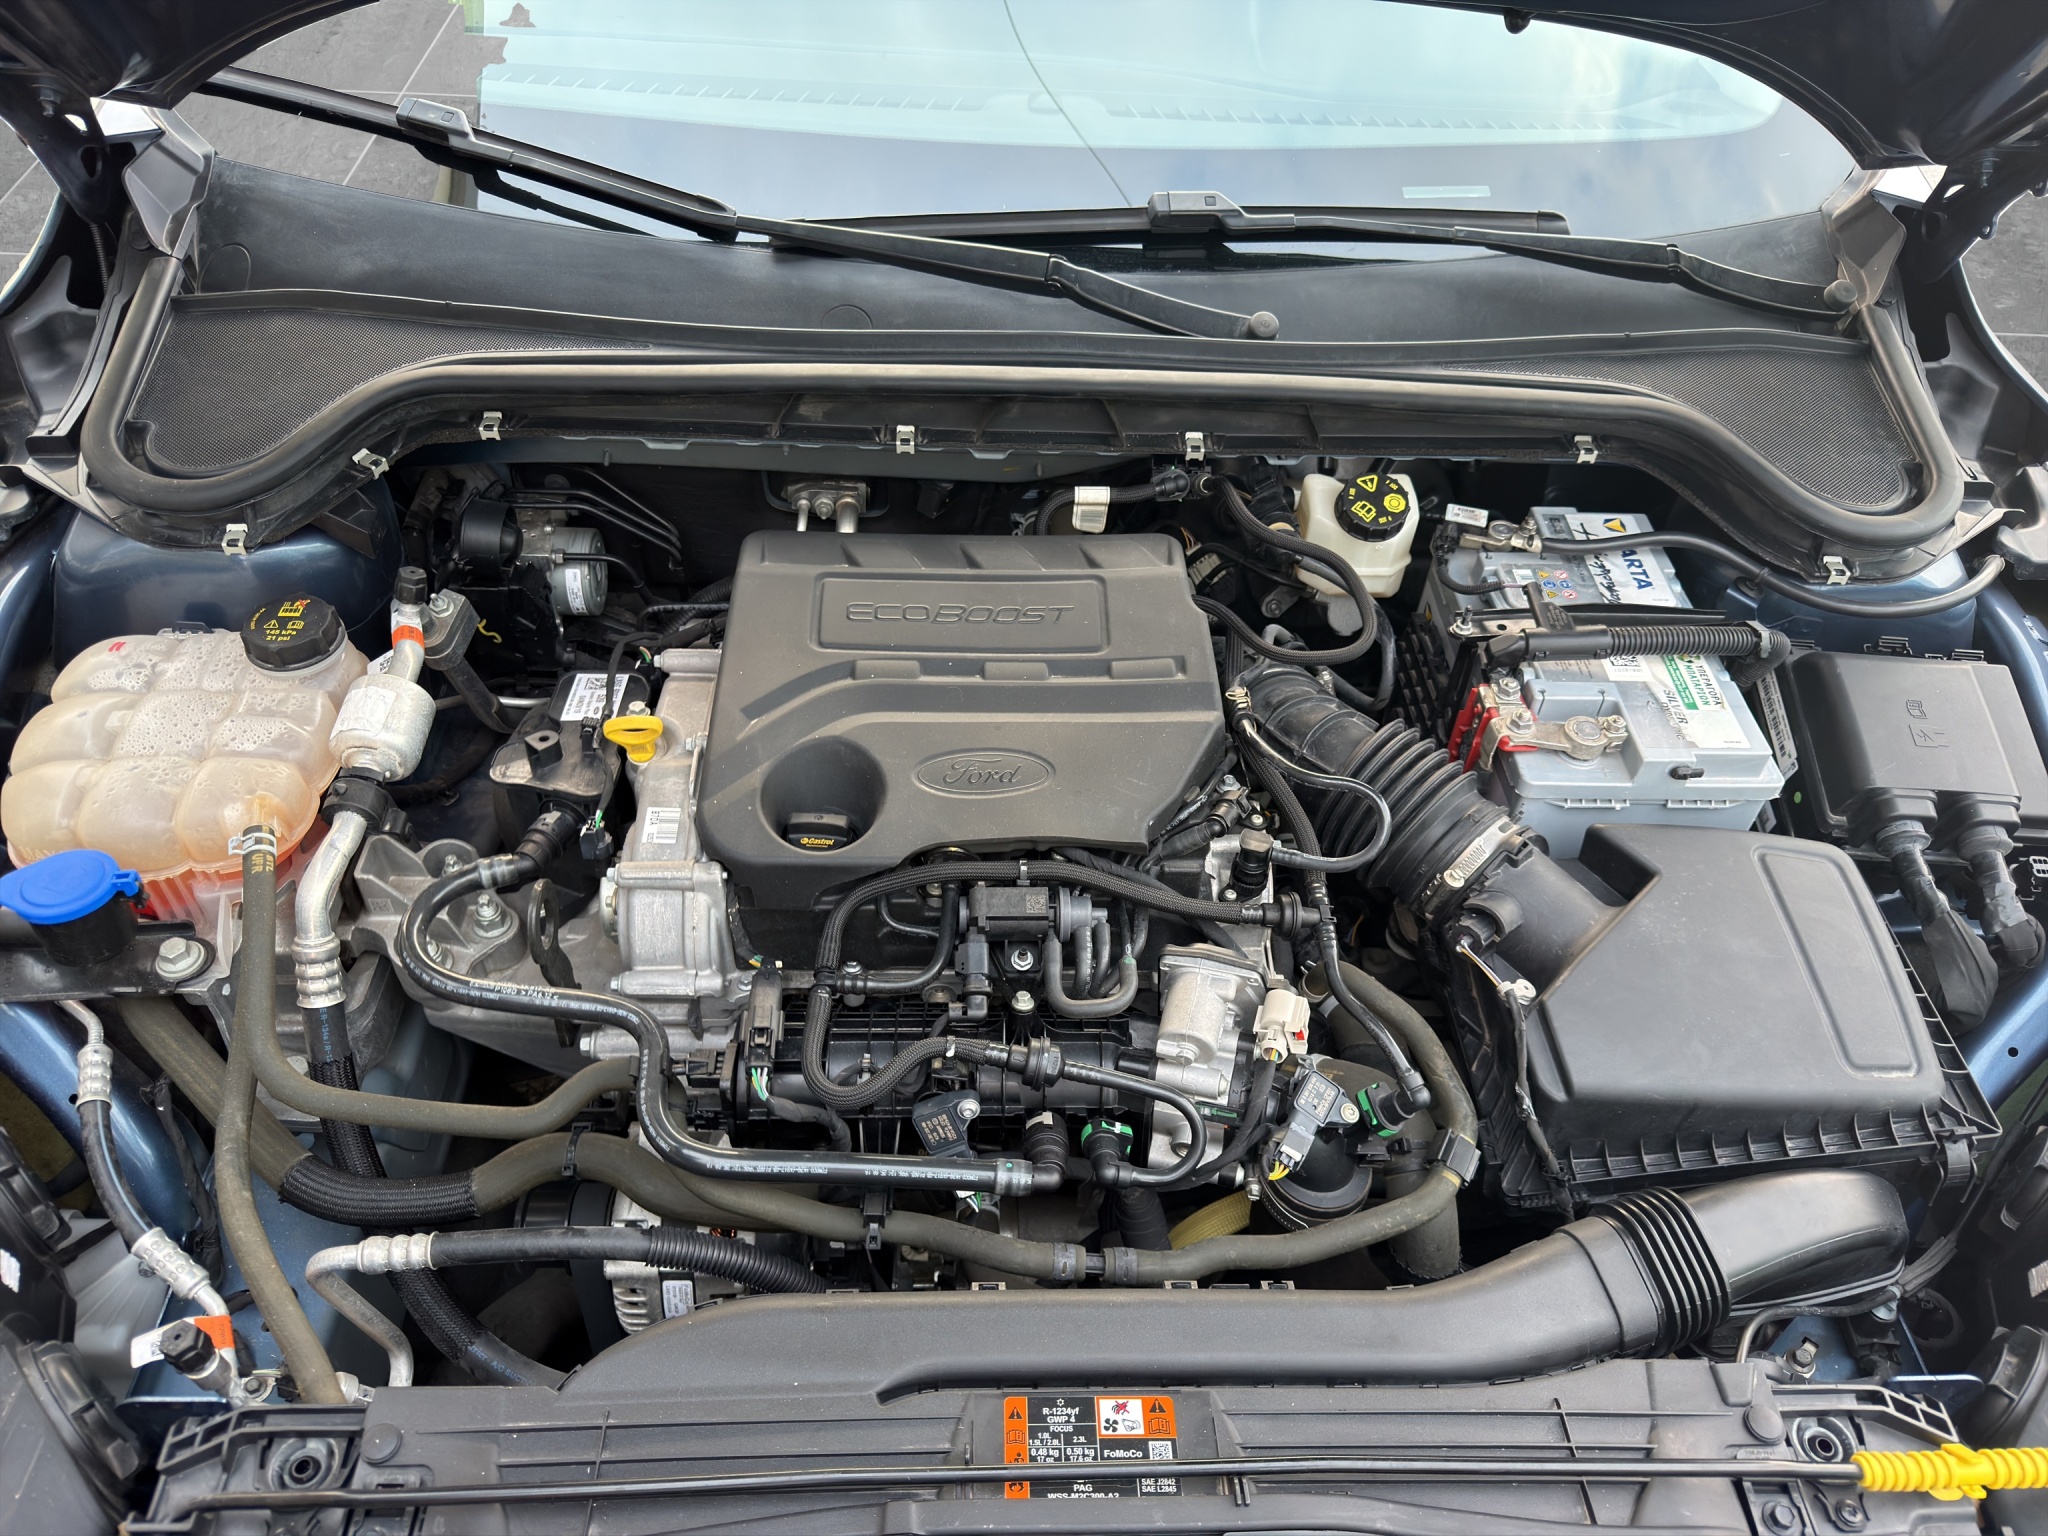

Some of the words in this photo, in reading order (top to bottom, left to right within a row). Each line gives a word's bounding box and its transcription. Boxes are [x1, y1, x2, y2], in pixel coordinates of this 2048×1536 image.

[1621, 549, 1654, 590] ARTA
[1663, 689, 1689, 725] SILVER
[1660, 702, 1686, 740] DYNIC
[943, 757, 1022, 785] Ford
[808, 837, 835, 846] Castrol
[1042, 1407, 1079, 1416] R-1234yf
[1069, 1415, 1076, 1423] 4
[1031, 1448, 1047, 1456] 0.48
[1049, 1448, 1059, 1457] kg
[1066, 1448, 1083, 1456] 0.50
[1084, 1447, 1095, 1457] kg
[1103, 1449, 1143, 1458] FoMoCo
[1073, 1484, 1093, 1492] PAG
